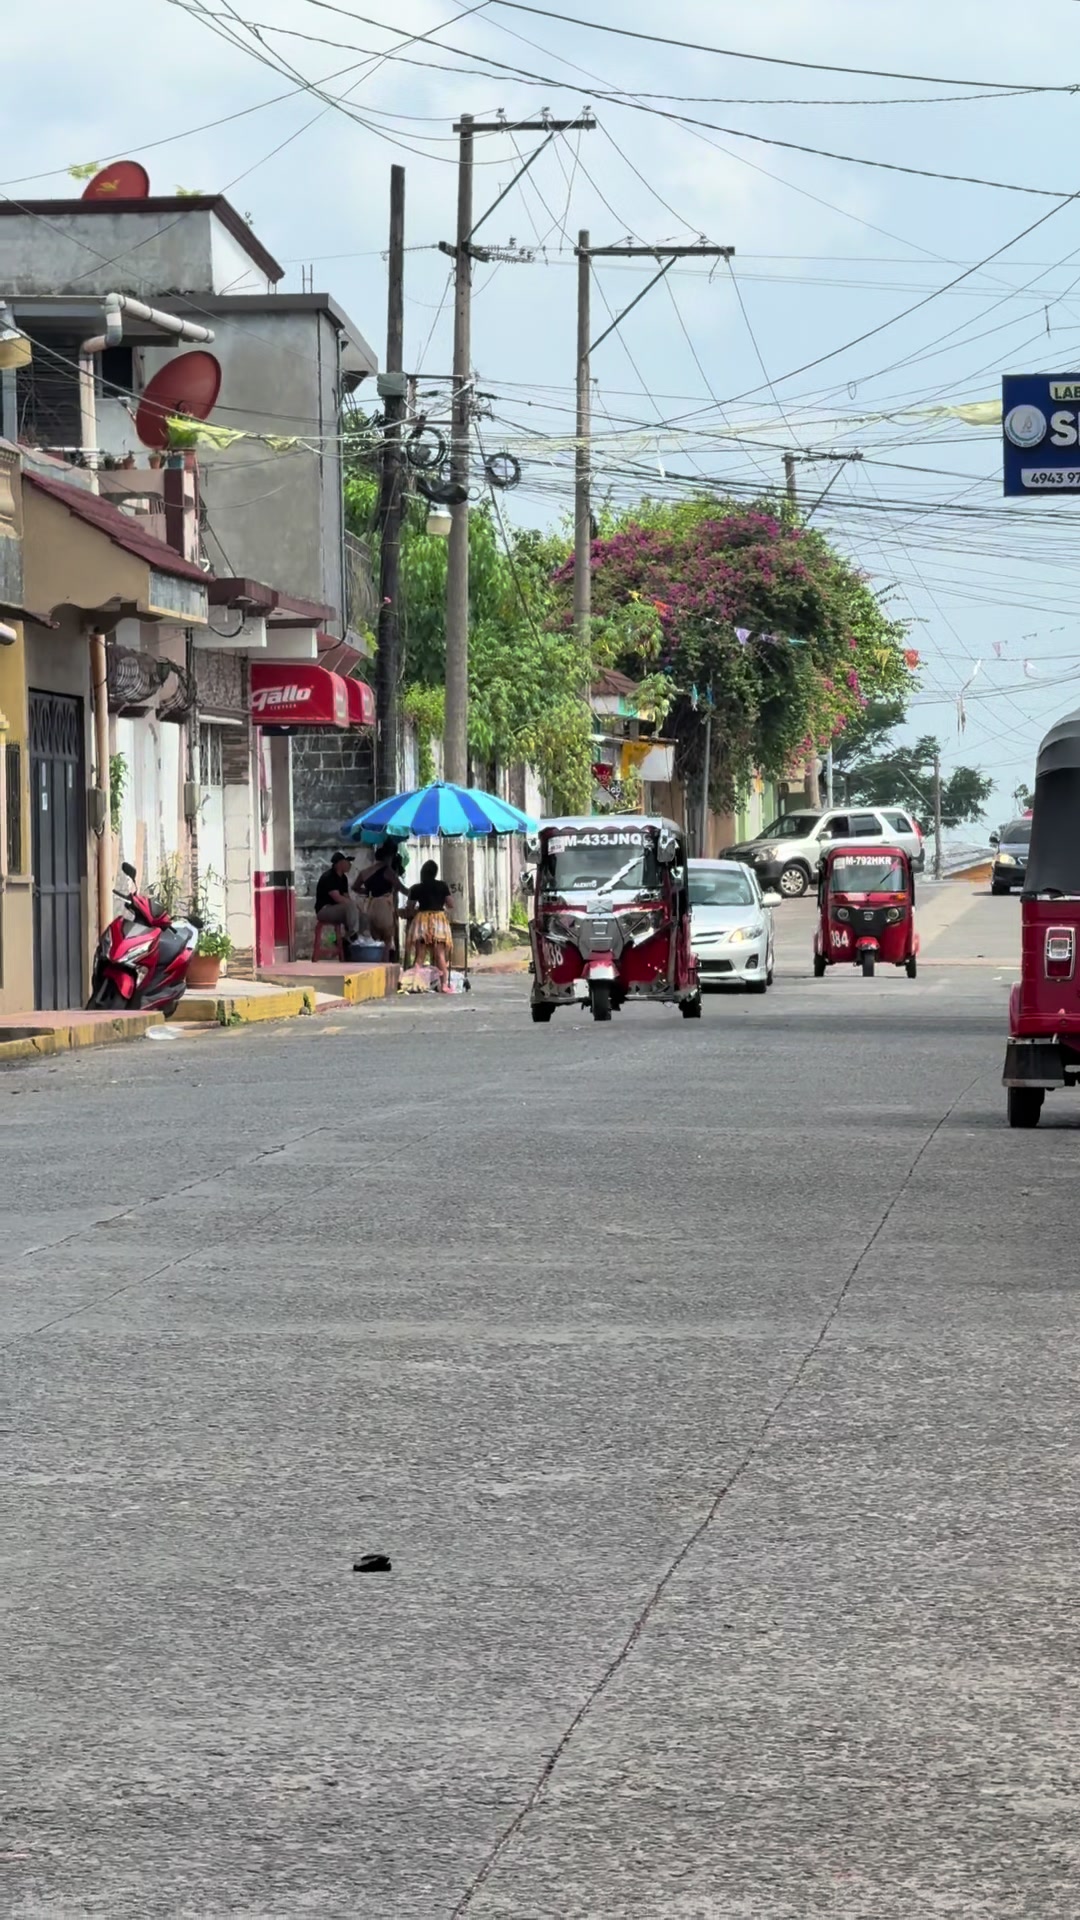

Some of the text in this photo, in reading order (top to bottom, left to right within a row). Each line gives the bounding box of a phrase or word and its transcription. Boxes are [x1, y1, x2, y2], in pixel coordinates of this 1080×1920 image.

[1050, 410, 1080, 446] S
[1031, 472, 1064, 484] 4943
[845, 856, 891, 866] M-792HKR
